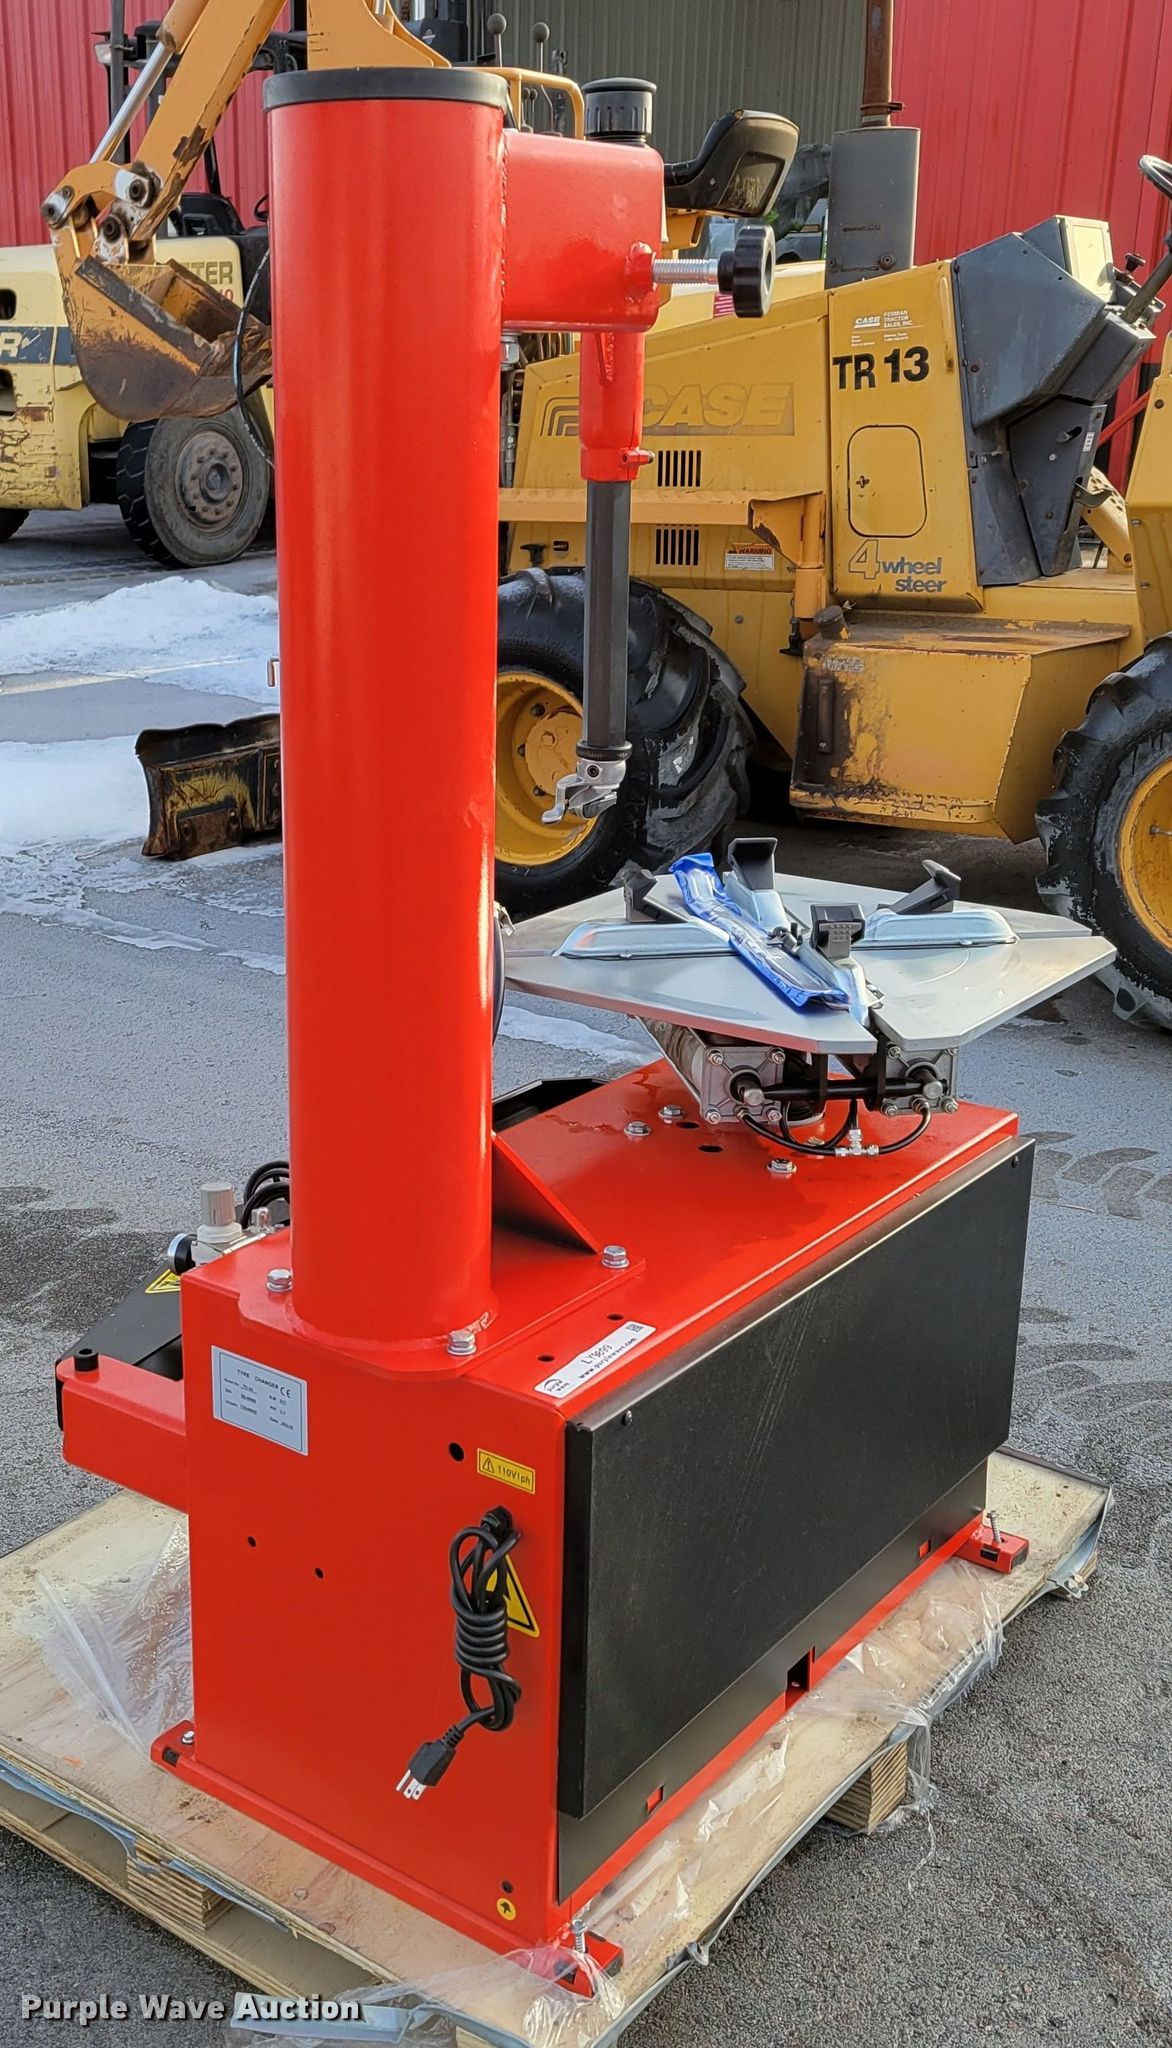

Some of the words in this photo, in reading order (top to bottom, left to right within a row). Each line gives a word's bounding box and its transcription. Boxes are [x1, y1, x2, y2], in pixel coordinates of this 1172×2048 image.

[855, 316, 881, 325] CASE
[832, 353, 876, 390] TR
[884, 346, 929, 383] 13
[642, 382, 793, 427] CASE
[848, 539, 881, 581] 4
[882, 556, 943, 575] wheel
[895, 576, 947, 593] steer
[236, 1369, 250, 1379] TYRE
[254, 1376, 279, 1390] CHANGER
